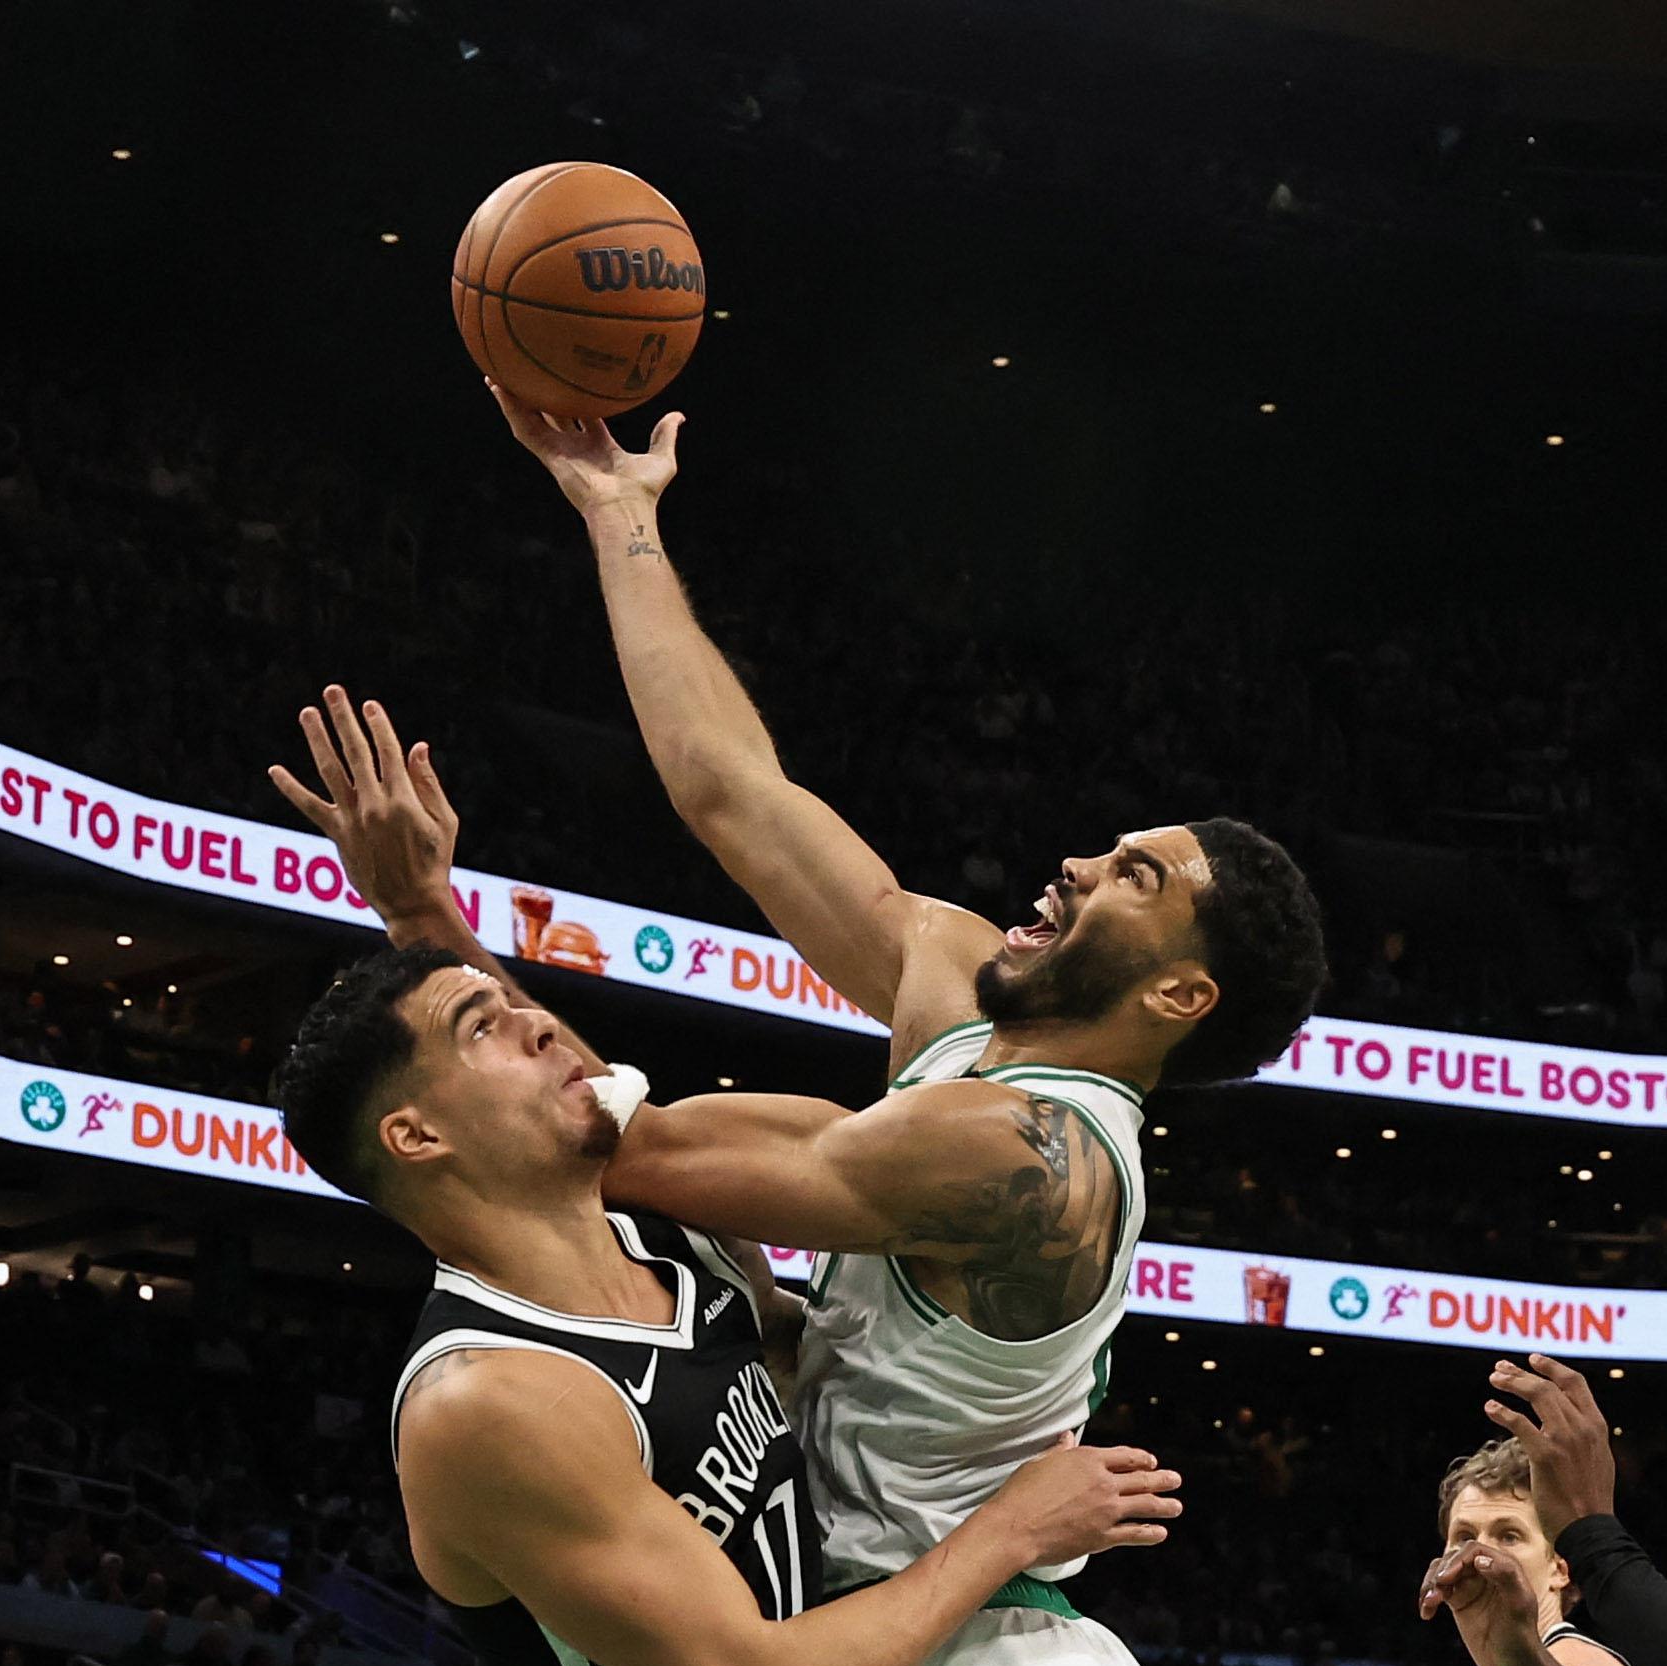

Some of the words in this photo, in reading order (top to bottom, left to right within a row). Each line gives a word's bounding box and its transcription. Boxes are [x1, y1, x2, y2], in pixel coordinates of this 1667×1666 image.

[574, 246, 704, 296] Wilson
[63, 789, 120, 850] TO
[133, 814, 258, 886] FUEL
[1325, 1035, 1392, 1081] TO
[1408, 1046, 1525, 1098] FUEL
[132, 1101, 307, 1176] DUNKI
[1429, 1289, 1626, 1344] DUNKIN'
[753, 1478, 803, 1622] 17
